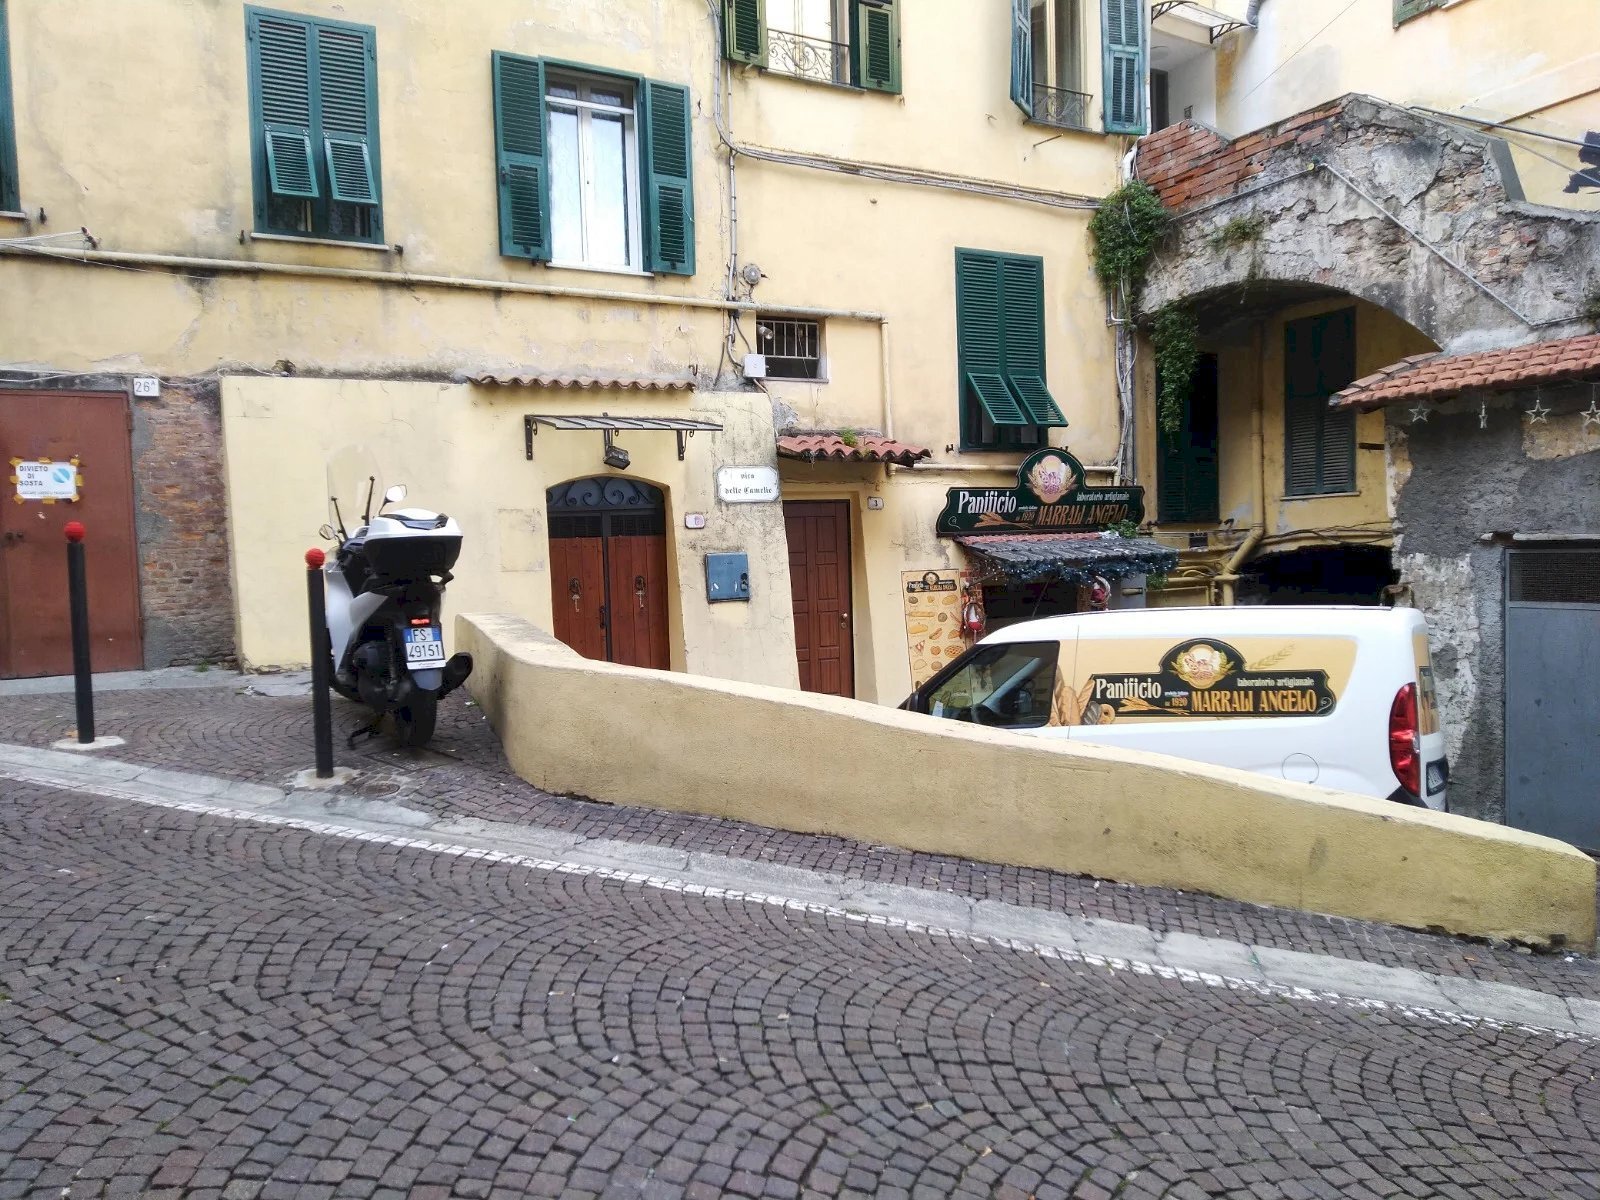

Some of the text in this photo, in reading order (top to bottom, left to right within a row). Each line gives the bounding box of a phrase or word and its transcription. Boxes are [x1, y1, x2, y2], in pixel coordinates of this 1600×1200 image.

[957, 490, 1017, 514] Panificio
[1076, 491, 1130, 502] laboratorio artigianale
[1036, 503, 1128, 525] MARRALI ANGELO
[412, 628, 427, 641] FS
[408, 644, 440, 658] 49151
[1095, 678, 1162, 699] Panificio
[1237, 677, 1315, 688] laboratorio artigianale
[1191, 689, 1317, 712] MARRALI ANGELO
